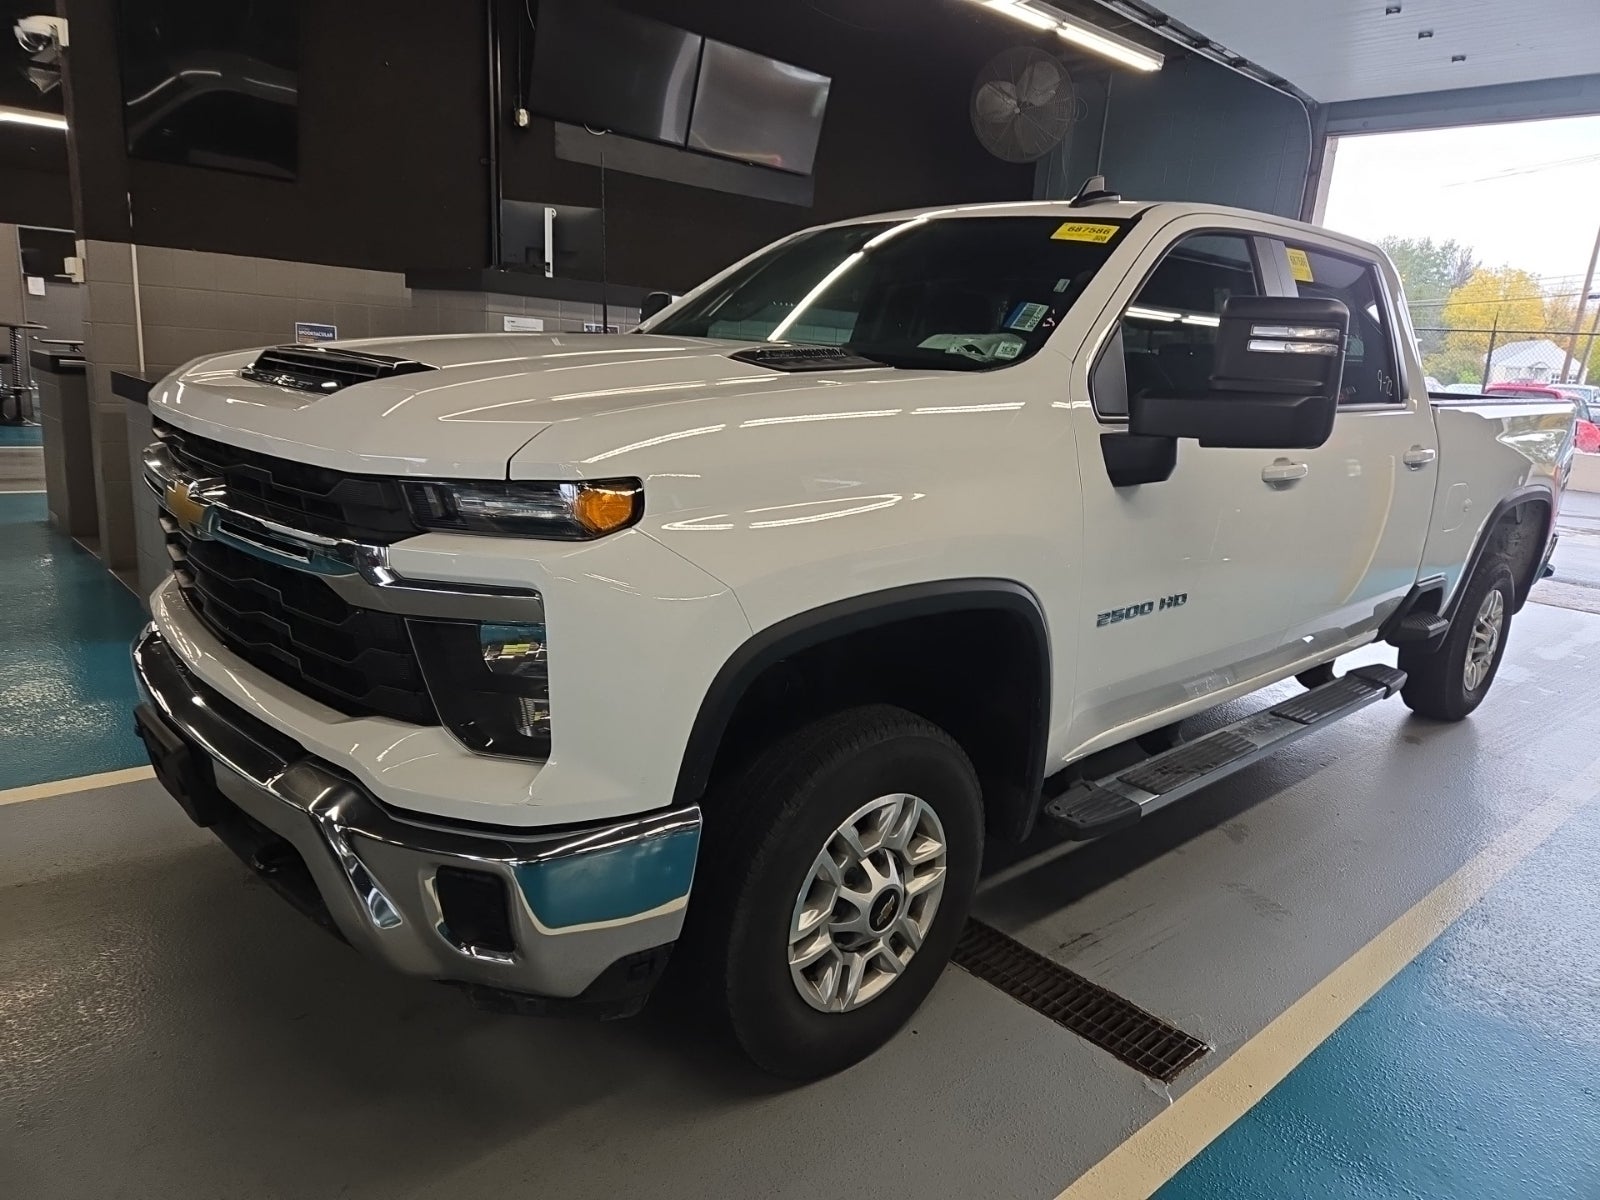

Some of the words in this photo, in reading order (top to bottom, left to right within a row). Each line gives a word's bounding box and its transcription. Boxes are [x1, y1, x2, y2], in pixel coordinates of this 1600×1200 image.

[1067, 226, 1111, 235] 687586
[1096, 601, 1155, 628] 2500
[1158, 593, 1188, 611] HD
